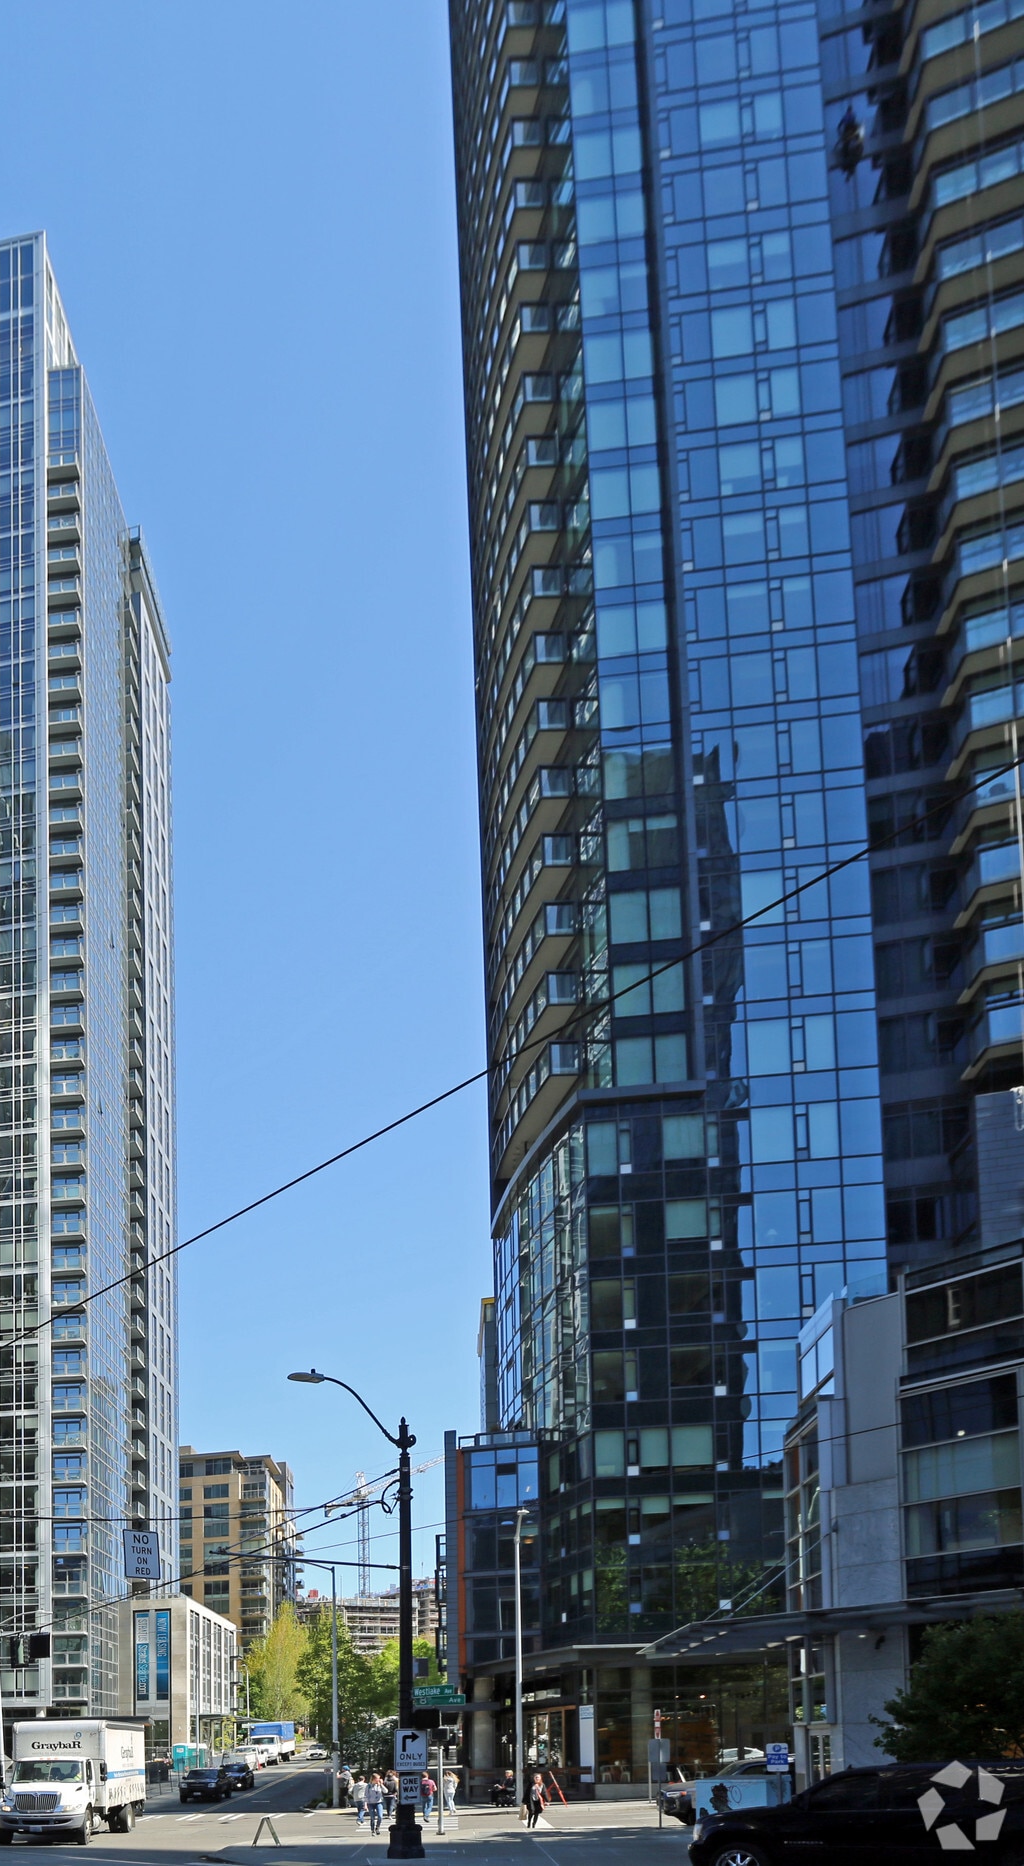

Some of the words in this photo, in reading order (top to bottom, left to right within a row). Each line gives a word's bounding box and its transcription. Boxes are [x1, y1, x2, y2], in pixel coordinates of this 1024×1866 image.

[133, 1534, 149, 1544] NO
[131, 1545, 152, 1555] TURN
[136, 1556, 148, 1565] ON
[135, 1567, 151, 1576] RED
[157, 1617, 167, 1632] NOW
[137, 1618, 148, 1642] STRATUS
[157, 1633, 167, 1657] LEASING
[414, 1688, 440, 1697] Westlake
[399, 1753, 423, 1761] ONLY
[402, 1785, 419, 1793] WAY
